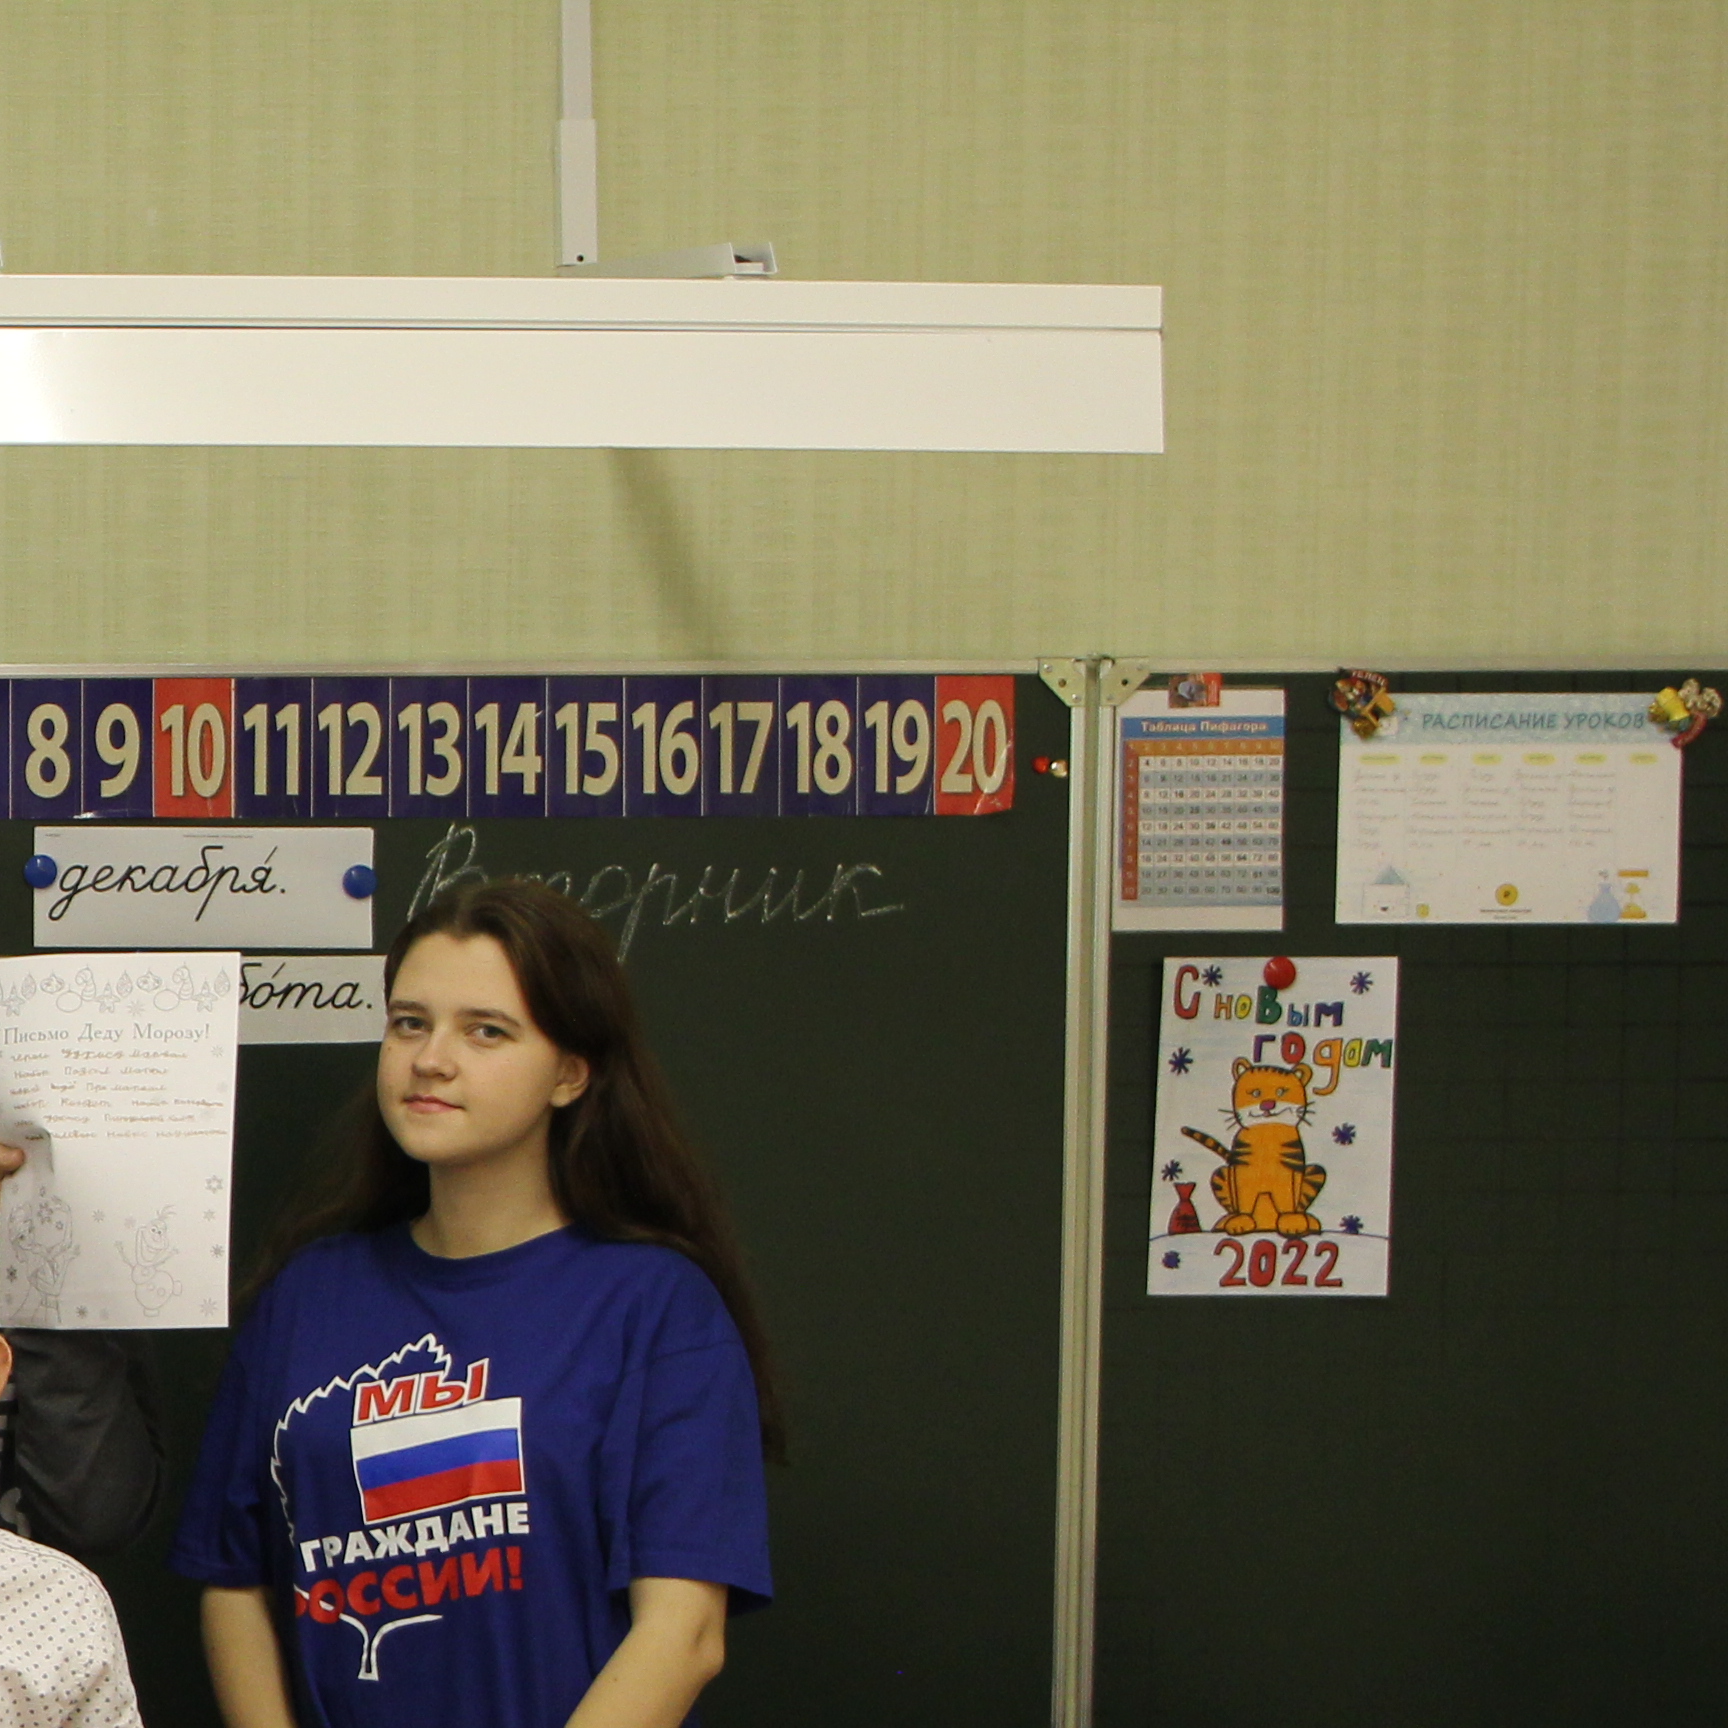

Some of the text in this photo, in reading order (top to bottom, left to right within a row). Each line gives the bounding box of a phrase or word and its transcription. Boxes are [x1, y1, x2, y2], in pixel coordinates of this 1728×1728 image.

[1141, 720, 1268, 733] Таблица Пифагора
[1422, 711, 1645, 731] РАСПИСАНИЕ УРОКОВ
[25, 703, 71, 798] 8
[95, 703, 140, 798] 9
[160, 703, 226, 798] 10
[243, 703, 300, 796] 11
[317, 702, 382, 796] 12
[398, 702, 462, 796] 13
[474, 702, 542, 795] 14
[555, 702, 619, 796] 15
[632, 701, 699, 795] 16
[709, 702, 773, 794] 17
[786, 700, 852, 795] 18
[864, 699, 930, 794] 19
[941, 699, 1011, 795] 20
[1173, 964, 1201, 1020] С
[4, 1021, 211, 1046] Письмо Деду Морозу!
[1212, 1238, 1343, 1288] 2022
[352, 1357, 490, 1427] МЫ
[299, 1501, 530, 1573] ГРАЖДАНЕ
